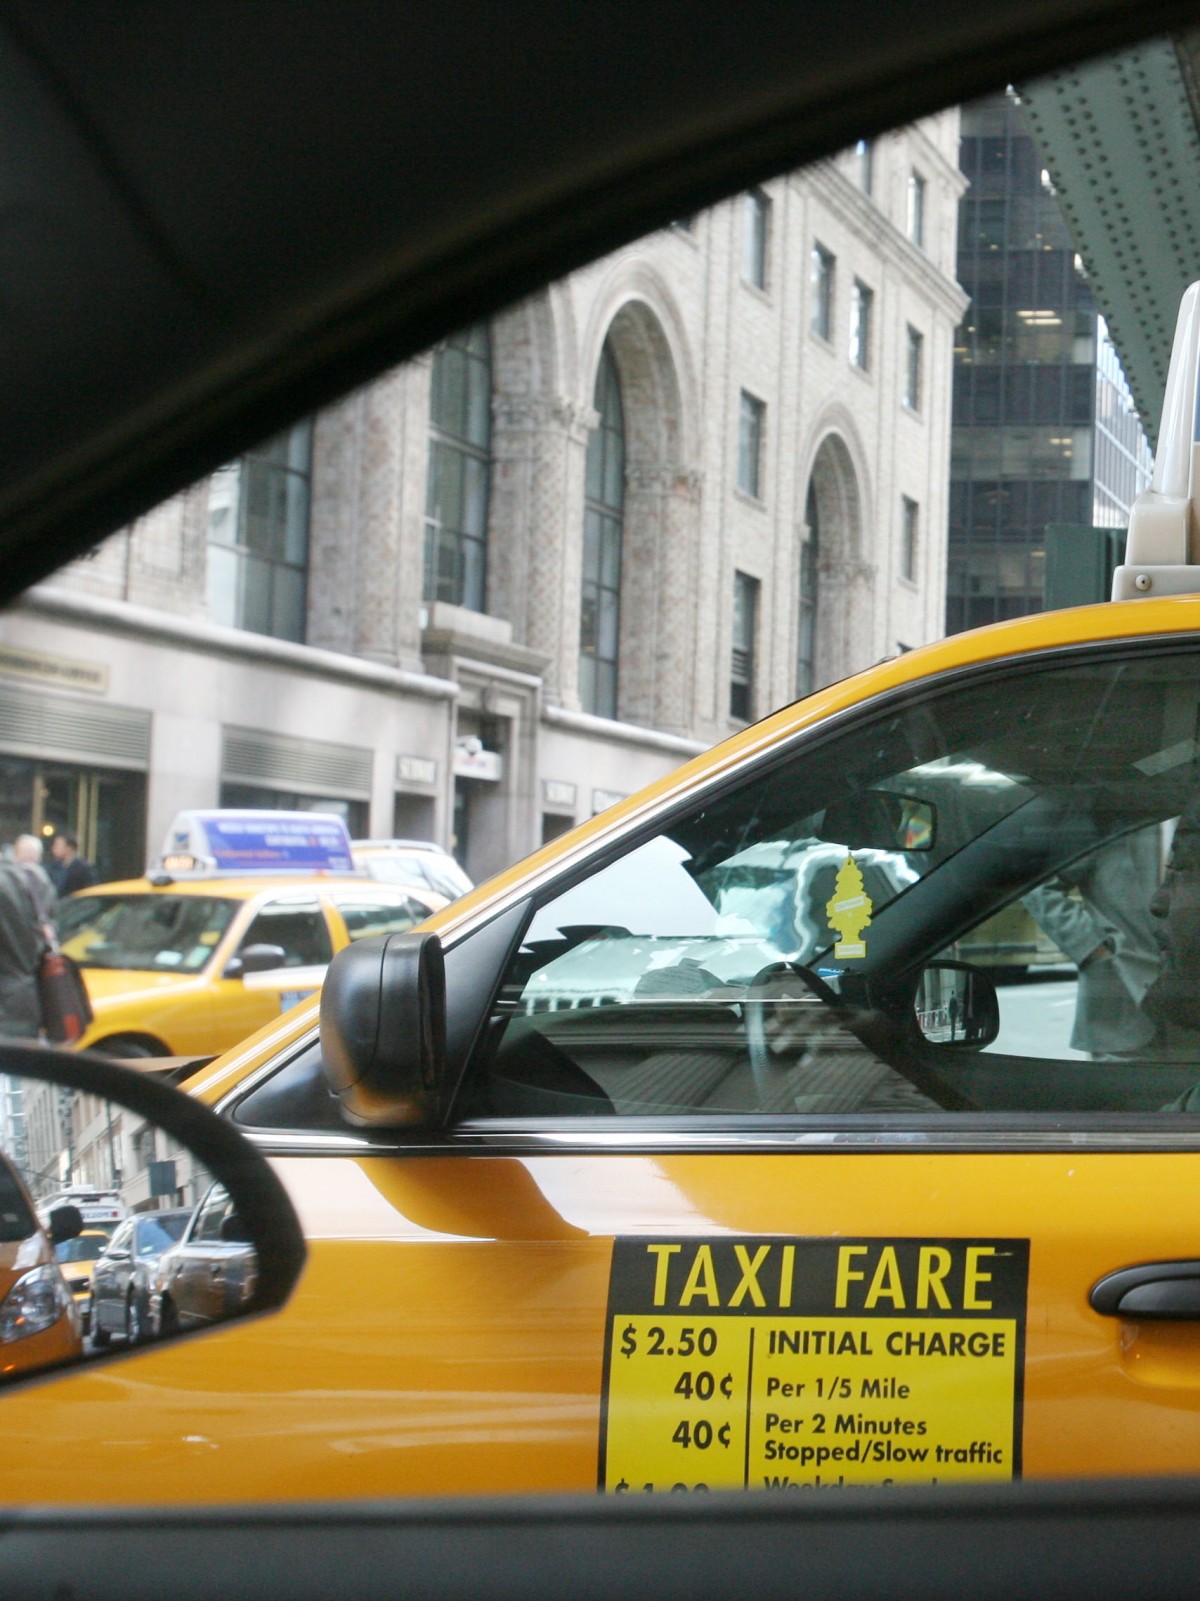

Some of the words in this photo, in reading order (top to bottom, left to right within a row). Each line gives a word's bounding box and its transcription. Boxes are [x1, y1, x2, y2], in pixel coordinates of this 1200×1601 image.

[647, 1244, 795, 1307] TAXI
[835, 1246, 996, 1310] FARE
[768, 1330, 873, 1356] INITIAL
[885, 1331, 1005, 1357] CHARGE
[766, 1377, 805, 1398] Per
[814, 1377, 851, 1400] 1/5
[861, 1376, 910, 1399] Mile
[765, 1413, 803, 1433] Per
[812, 1413, 826, 1434] 2
[834, 1413, 927, 1436] Minutes
[764, 1440, 929, 1466] Stopped/Slow
[935, 1441, 1003, 1465] traffic
